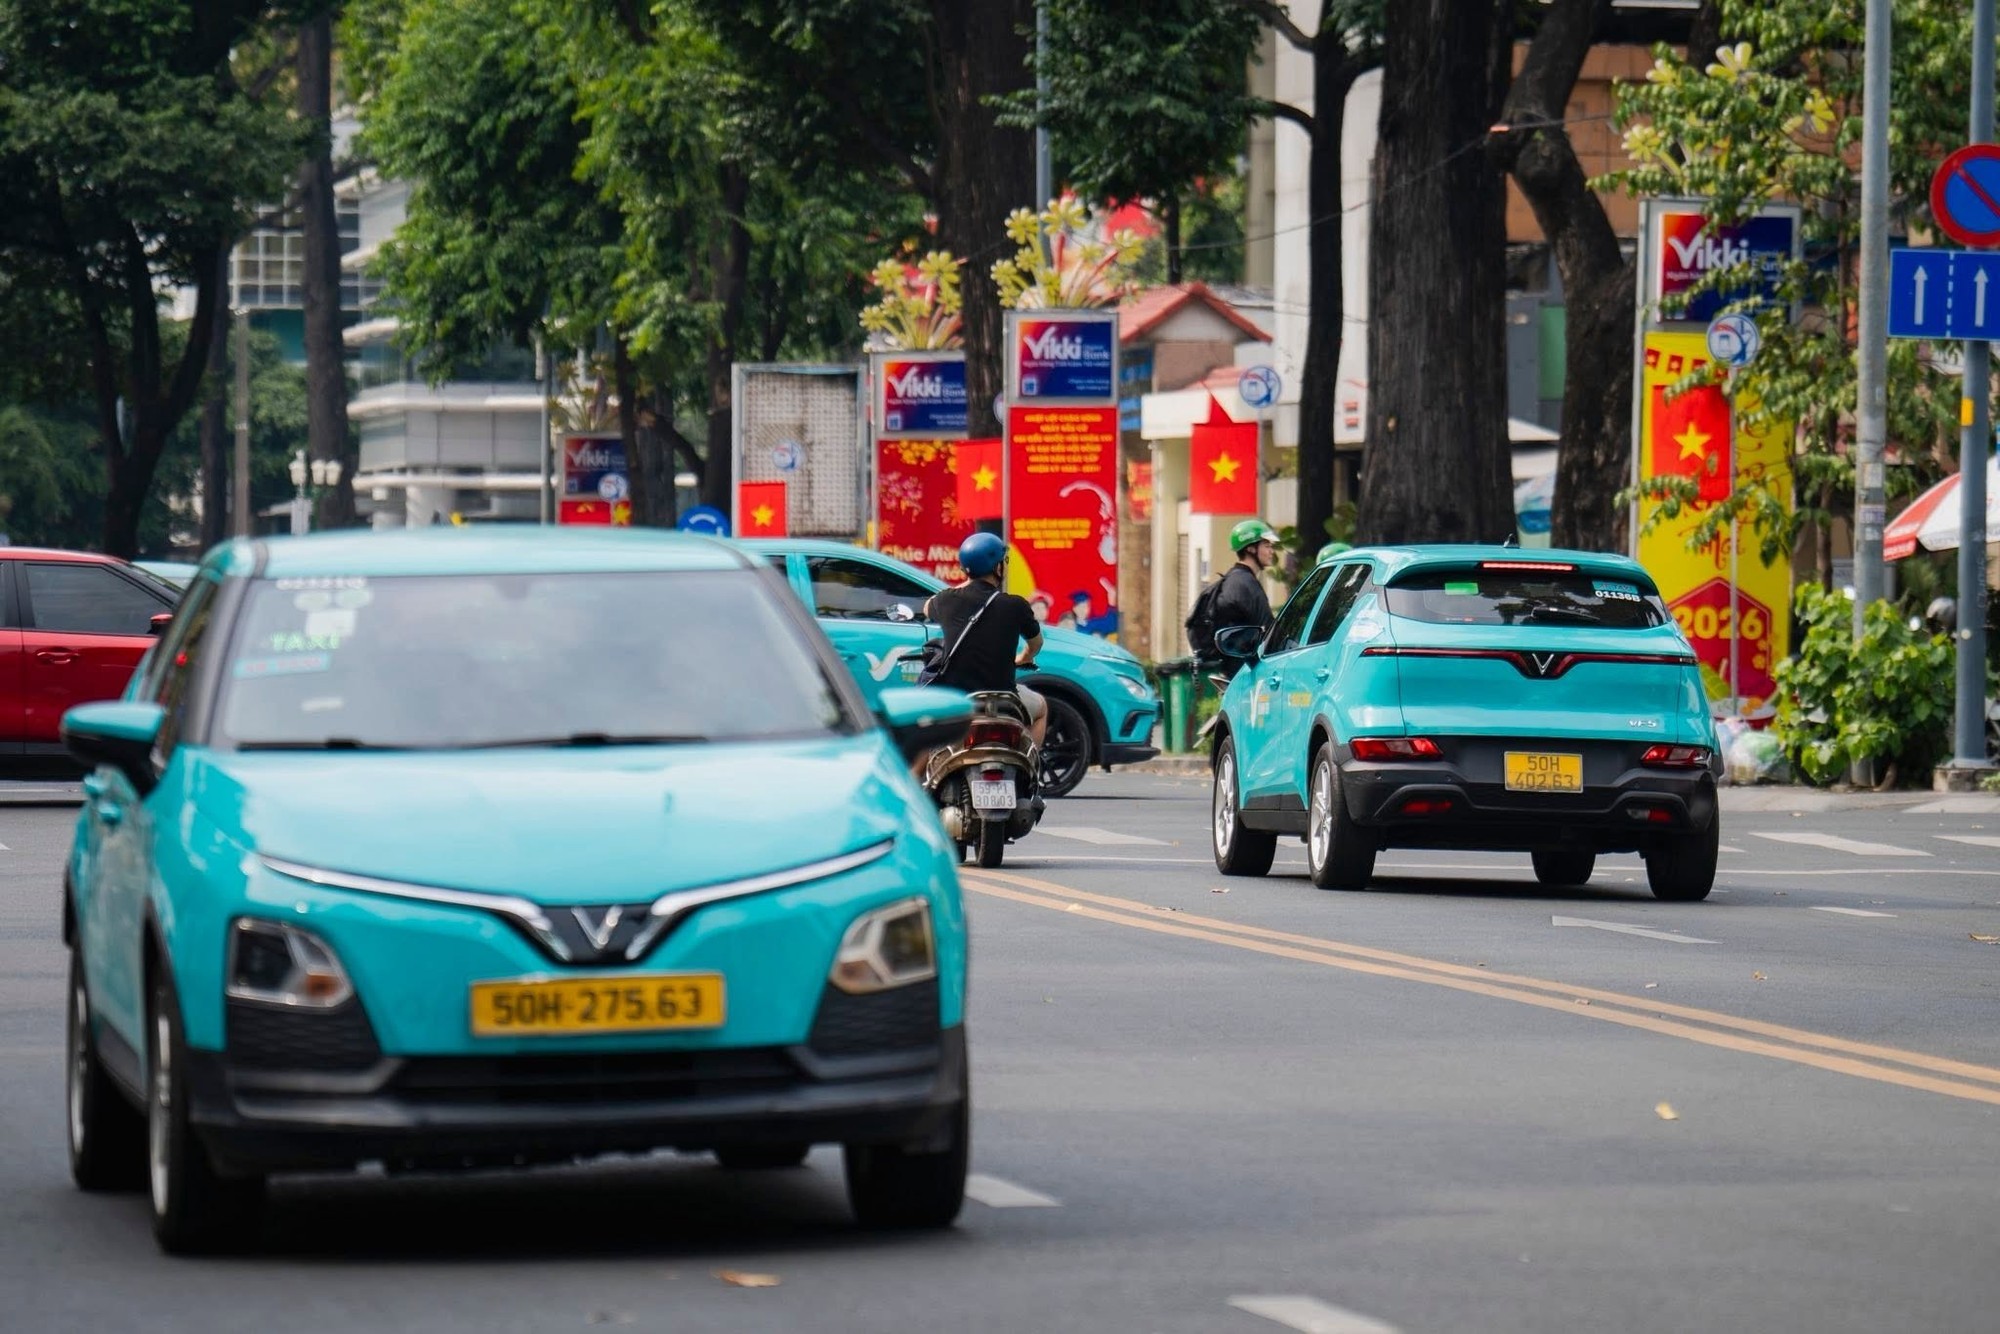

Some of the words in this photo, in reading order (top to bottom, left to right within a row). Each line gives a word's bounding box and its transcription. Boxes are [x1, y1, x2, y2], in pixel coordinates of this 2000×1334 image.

[1668, 231, 1749, 270] Vikki
[1023, 326, 1082, 360] Vikki
[887, 365, 942, 398] Vikki
[566, 441, 609, 467] Vikki
[1671, 605, 1763, 640] 2026
[1527, 756, 1560, 771] 50H
[492, 986, 703, 1026] 50H-275.63
